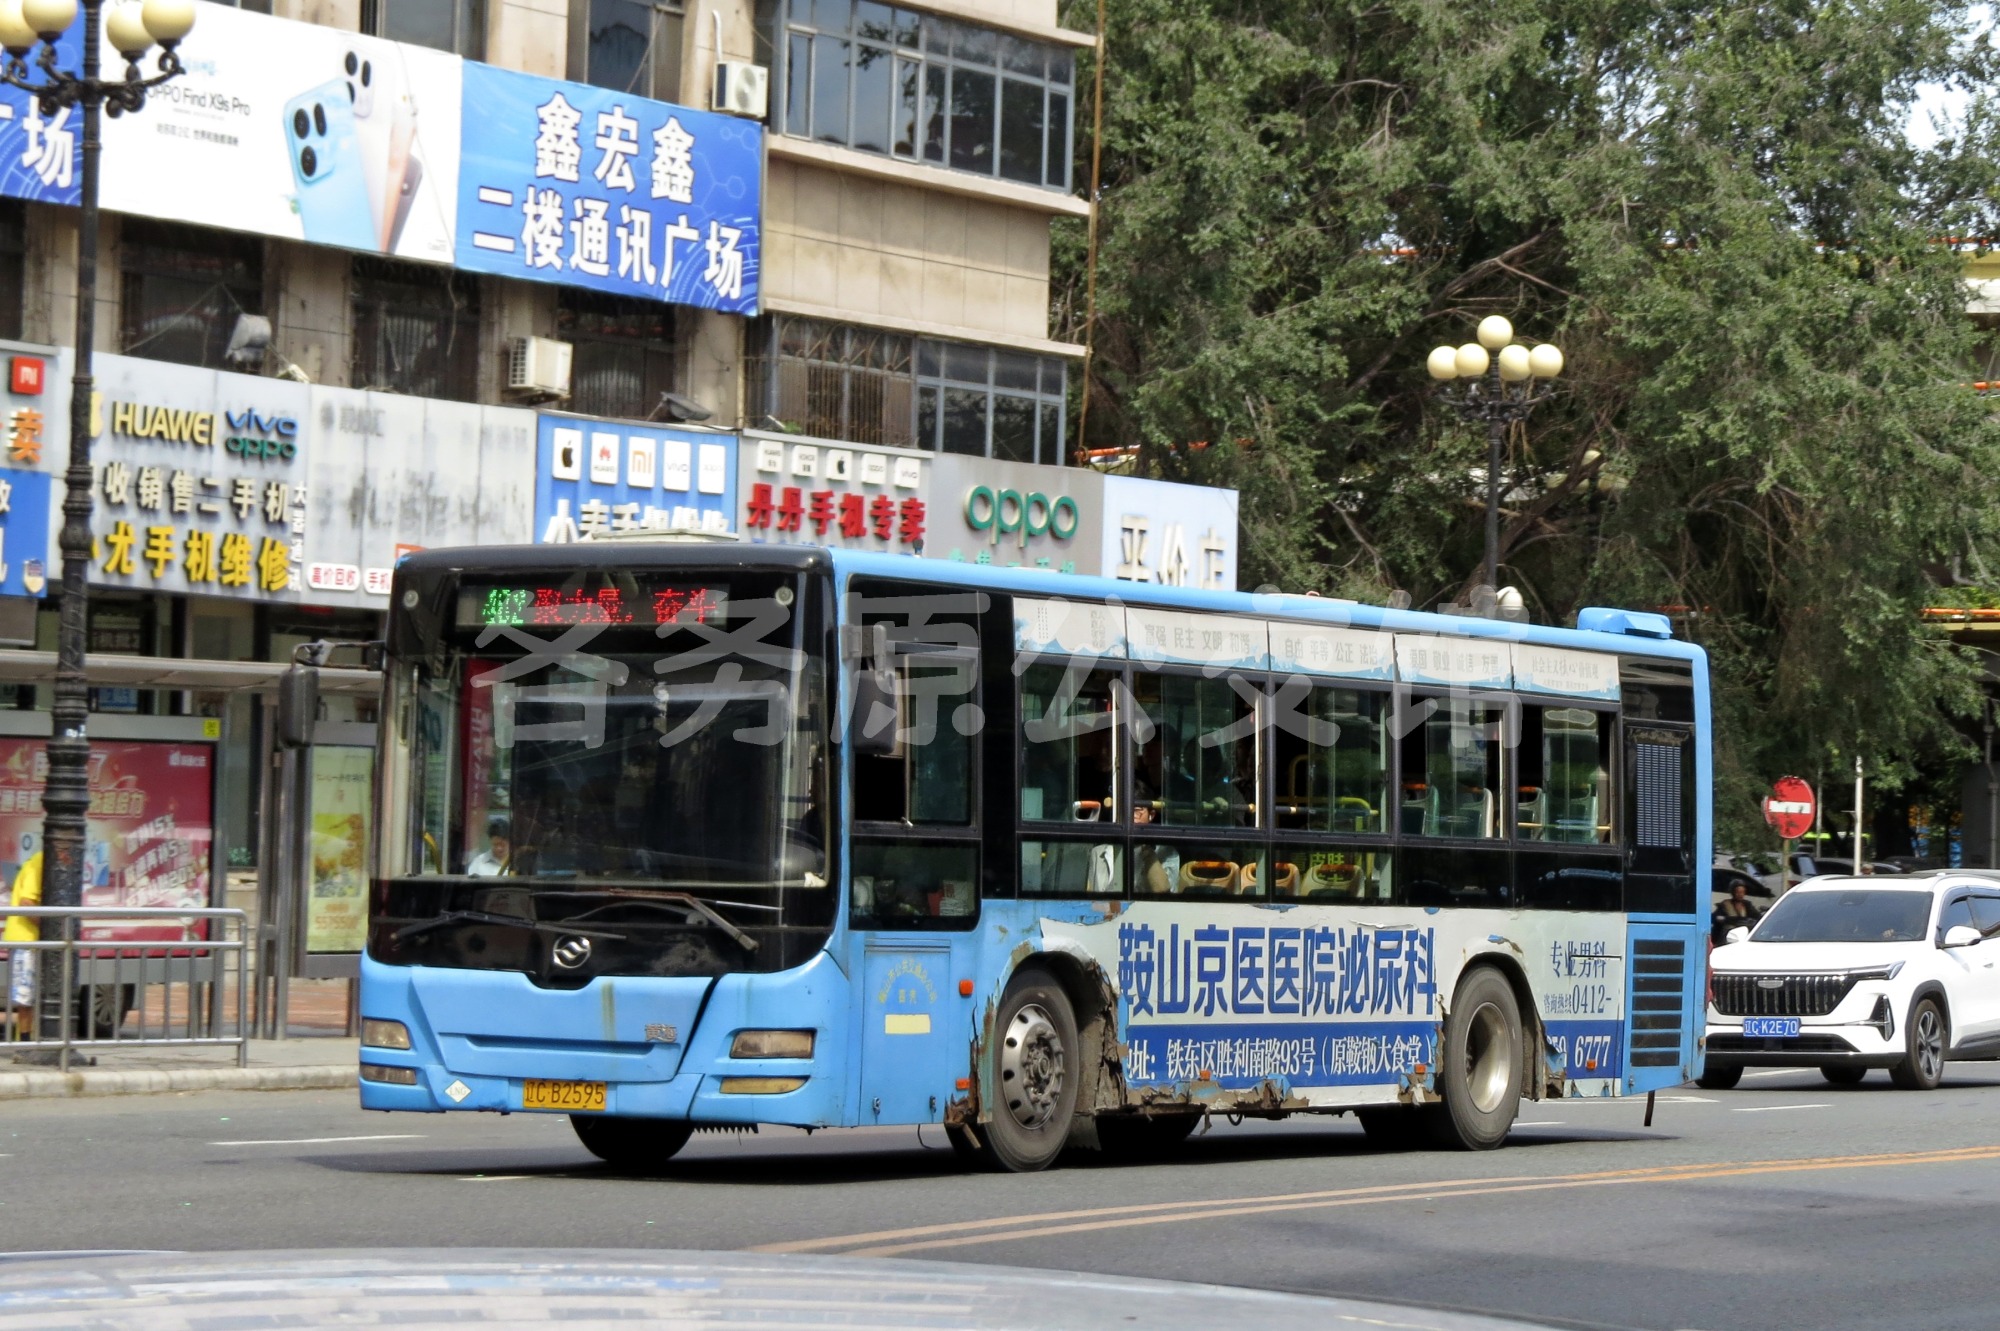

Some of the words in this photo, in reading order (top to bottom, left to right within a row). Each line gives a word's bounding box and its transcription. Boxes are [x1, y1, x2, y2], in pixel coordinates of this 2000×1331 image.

[183, 87, 206, 108] Find
[209, 92, 230, 112] X9s
[231, 97, 251, 116] Pro
[534, 90, 696, 205] 鑫宏鑫
[472, 184, 744, 300] 二楼通讯广场
[112, 401, 218, 446] HUAWEI
[225, 406, 299, 436] vivo
[225, 436, 298, 460] oppo
[91, 461, 290, 523] 收销售二手机
[746, 482, 927, 544] 丹丹手机专卖
[963, 485, 1080, 549] oppo
[91, 520, 291, 592] 尤手机维修
[1174, 628, 1195, 650] 民主
[1202, 630, 1223, 652] 文明
[1229, 632, 1251, 655] 和谐
[1285, 638, 1304, 660] 自由
[1310, 640, 1329, 662] 平等
[1335, 642, 1354, 664] 公正
[1359, 643, 1379, 666] 法治
[1410, 649, 1427, 670] 爱国
[1432, 650, 1450, 672] 敬业
[1481, 654, 1499, 675] 友善
[1118, 921, 1437, 1018] 鞍山京医医院泌尿科
[1550, 940, 1607, 979] 专业男科
[1574, 1035, 1612, 1068] 6777
